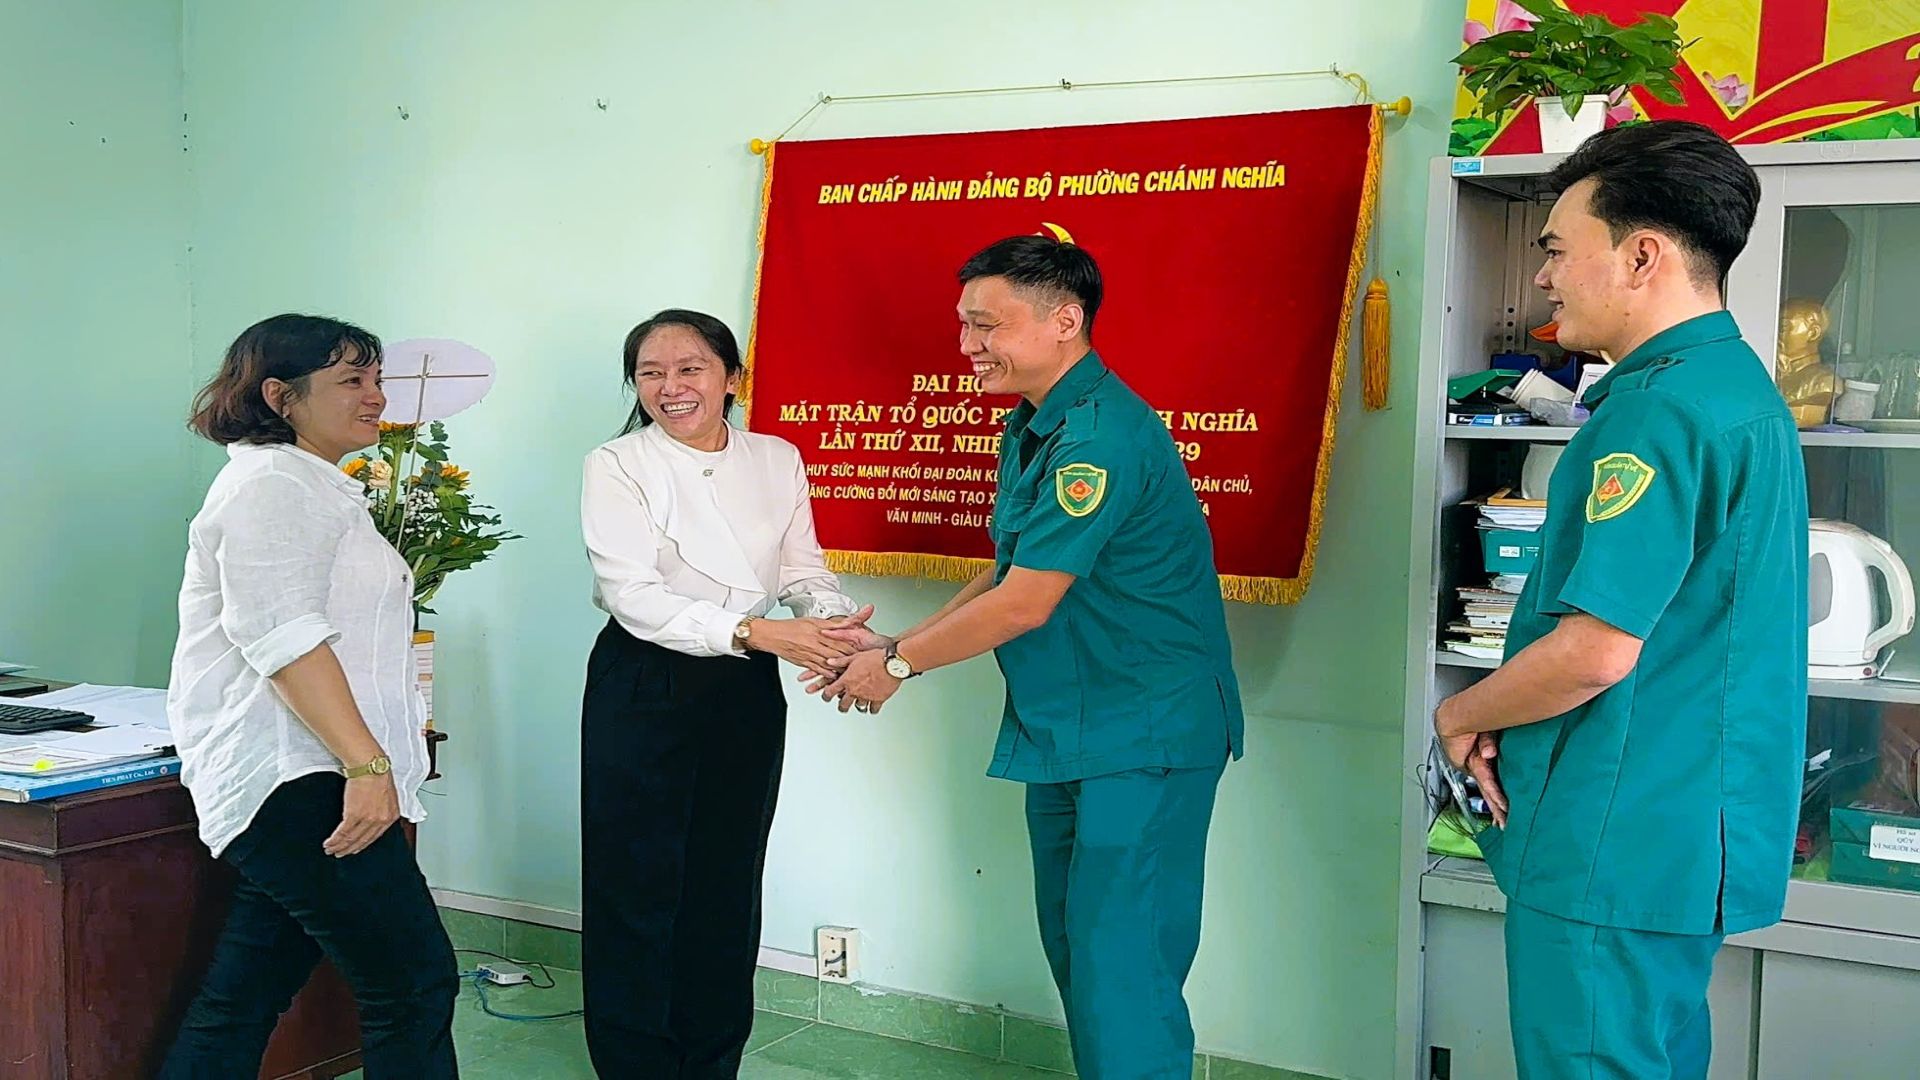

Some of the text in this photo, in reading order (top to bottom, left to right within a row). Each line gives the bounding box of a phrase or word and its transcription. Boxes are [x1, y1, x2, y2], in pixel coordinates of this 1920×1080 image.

[818, 160, 1285, 204] BAN CHẤP HÀNH ĐẢNG BỘ PHƯỜNG CHÁNH NGHĨA
[912, 374, 951, 396] ĐẠI
[779, 400, 822, 425] MẶT
[826, 400, 883, 425] TRẬN
[889, 395, 917, 423] TỔ
[922, 398, 984, 428] QUỐC
[1180, 408, 1259, 432] NGHĨA
[818, 423, 856, 450] LẦN
[862, 429, 906, 451] THỨ
[909, 434, 945, 454] XII,
[951, 431, 1004, 459] NHIỆ
[806, 463, 830, 477] HUY
[830, 461, 855, 477] SỨC
[857, 464, 890, 480] MẠNH
[891, 462, 920, 481] KHỐI
[923, 467, 944, 483] ĐẠI
[945, 465, 983, 481] ĐOÀN
[1191, 475, 1220, 493] DÂN
[1222, 474, 1253, 496] CHỦ,
[808, 482, 831, 499] ĂNG
[833, 484, 875, 500] CƯỜNG
[877, 482, 897, 501] ĐỔI
[899, 485, 921, 501] MỚI
[922, 485, 956, 502] SÁNG
[959, 489, 986, 506] TẠO
[886, 507, 909, 523] VĂN
[911, 512, 941, 525] MINH
[951, 510, 983, 528] GIÀU
